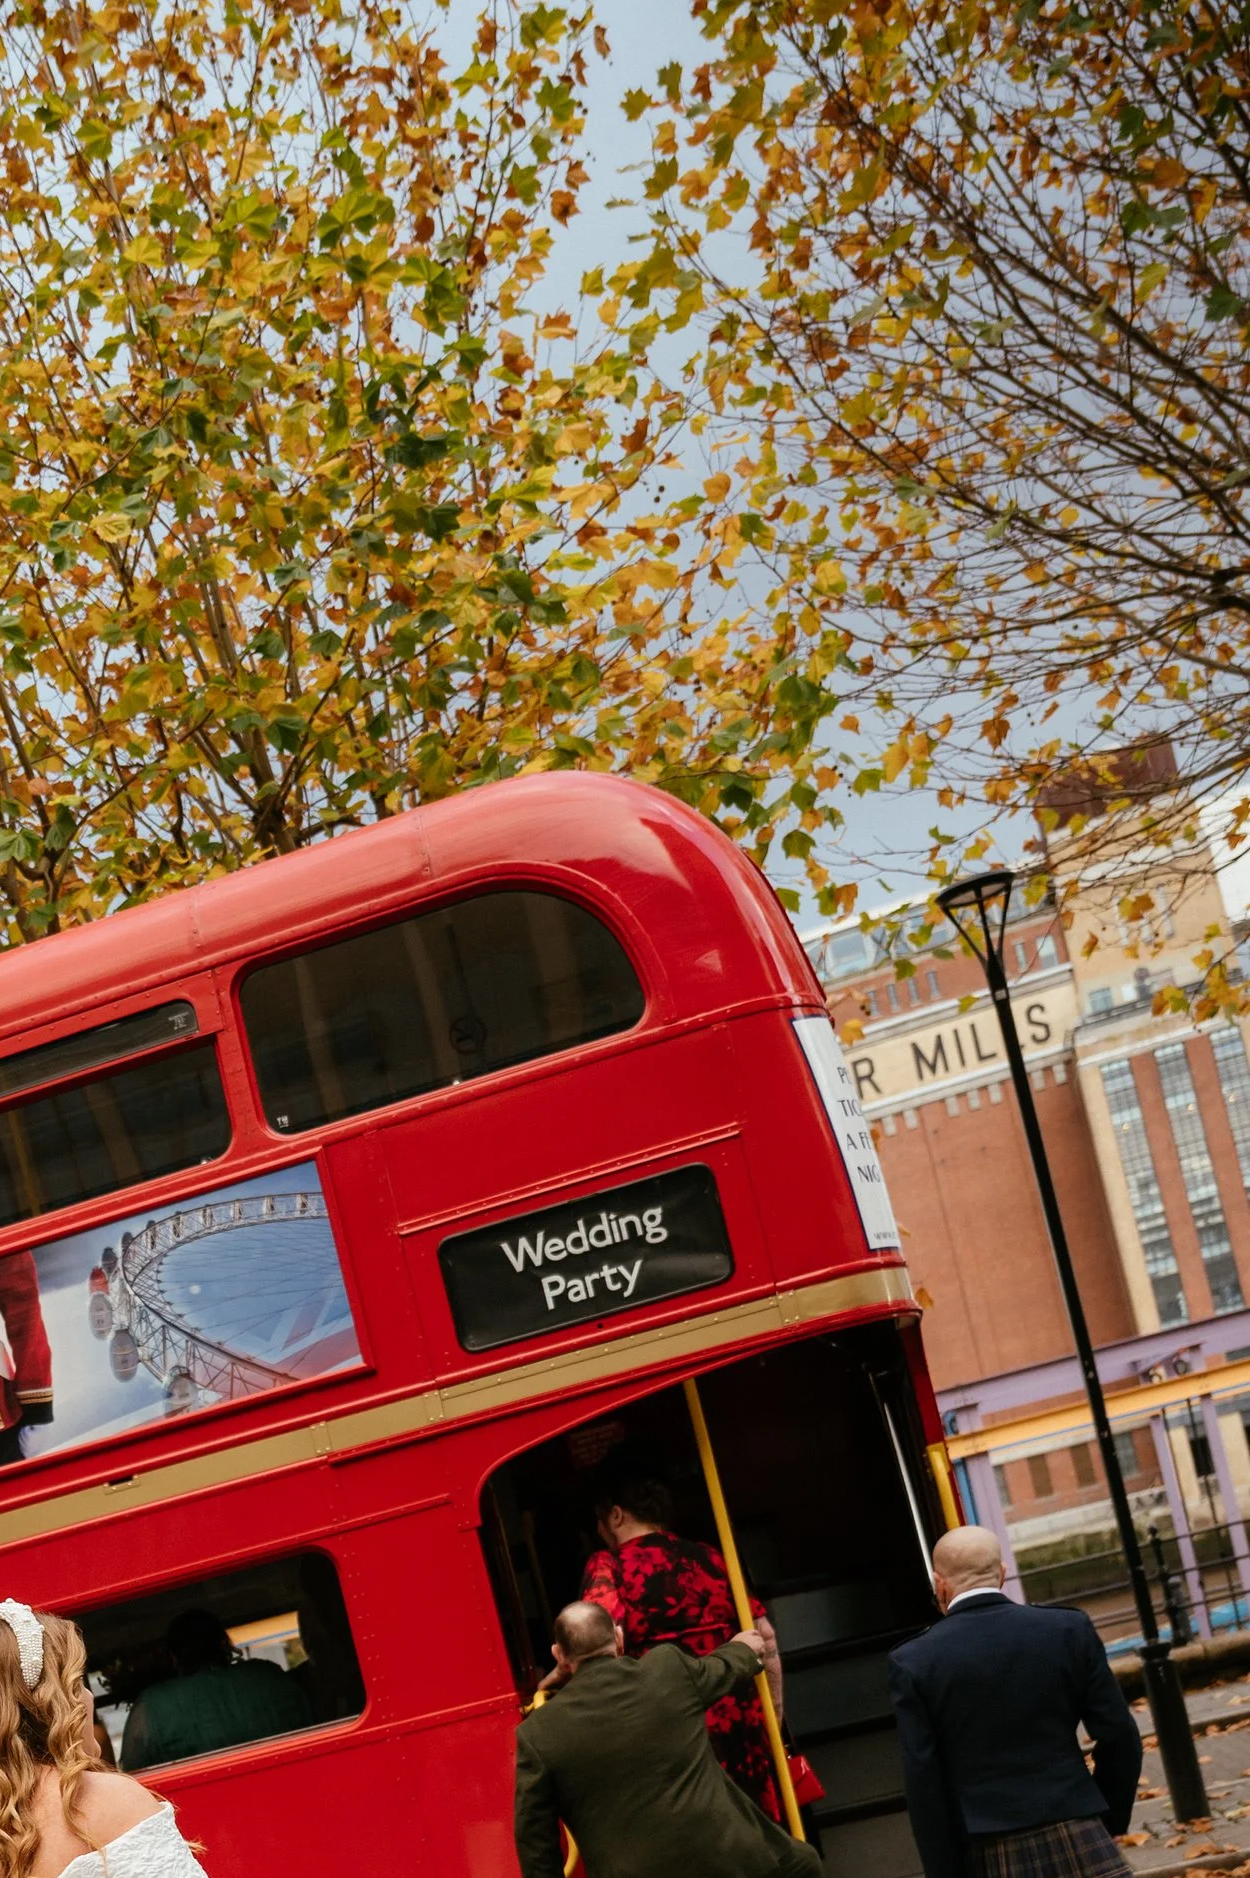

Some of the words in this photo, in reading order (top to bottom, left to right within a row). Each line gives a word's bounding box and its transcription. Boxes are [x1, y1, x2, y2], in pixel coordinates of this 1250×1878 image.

[910, 1003, 1051, 1081] MILS
[846, 1133, 858, 1150] A
[500, 1205, 669, 1273] Wedding
[541, 1259, 642, 1310] Party
